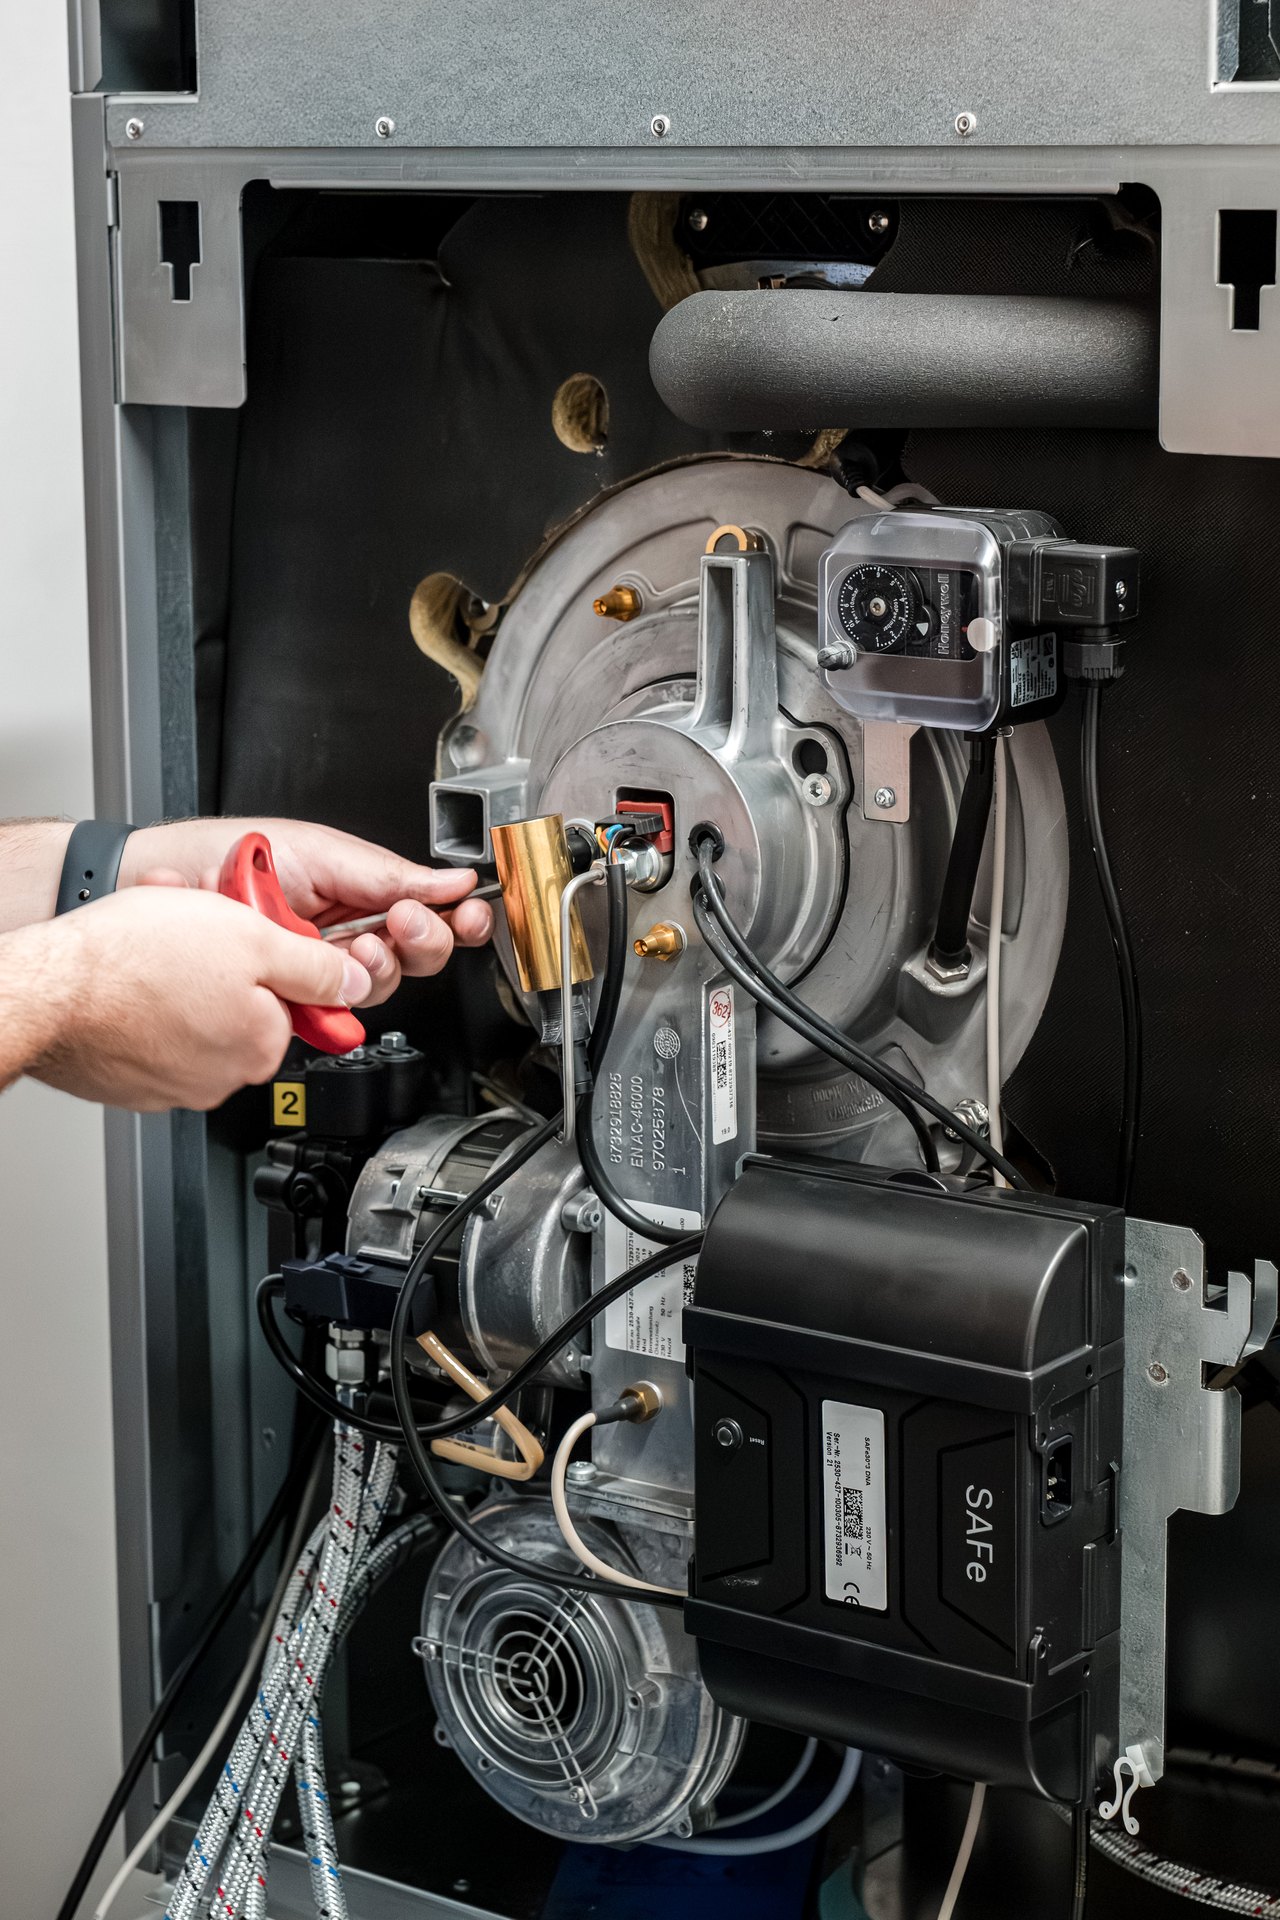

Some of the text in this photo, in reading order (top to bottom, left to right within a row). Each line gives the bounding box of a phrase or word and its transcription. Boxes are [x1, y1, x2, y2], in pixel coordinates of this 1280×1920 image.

[937, 573, 952, 655] Honeywell
[712, 1001, 728, 1018] 362
[282, 1091, 299, 1115] 2
[609, 1073, 622, 1163] 8732918825
[630, 1075, 644, 1168] EN AC-46000
[652, 1087, 665, 1171] 97025878
[749, 1437, 765, 1445] Reset
[827, 1459, 833, 1467] 21
[965, 1484, 993, 1583] SAFe
[866, 1561, 872, 1571] Hz
